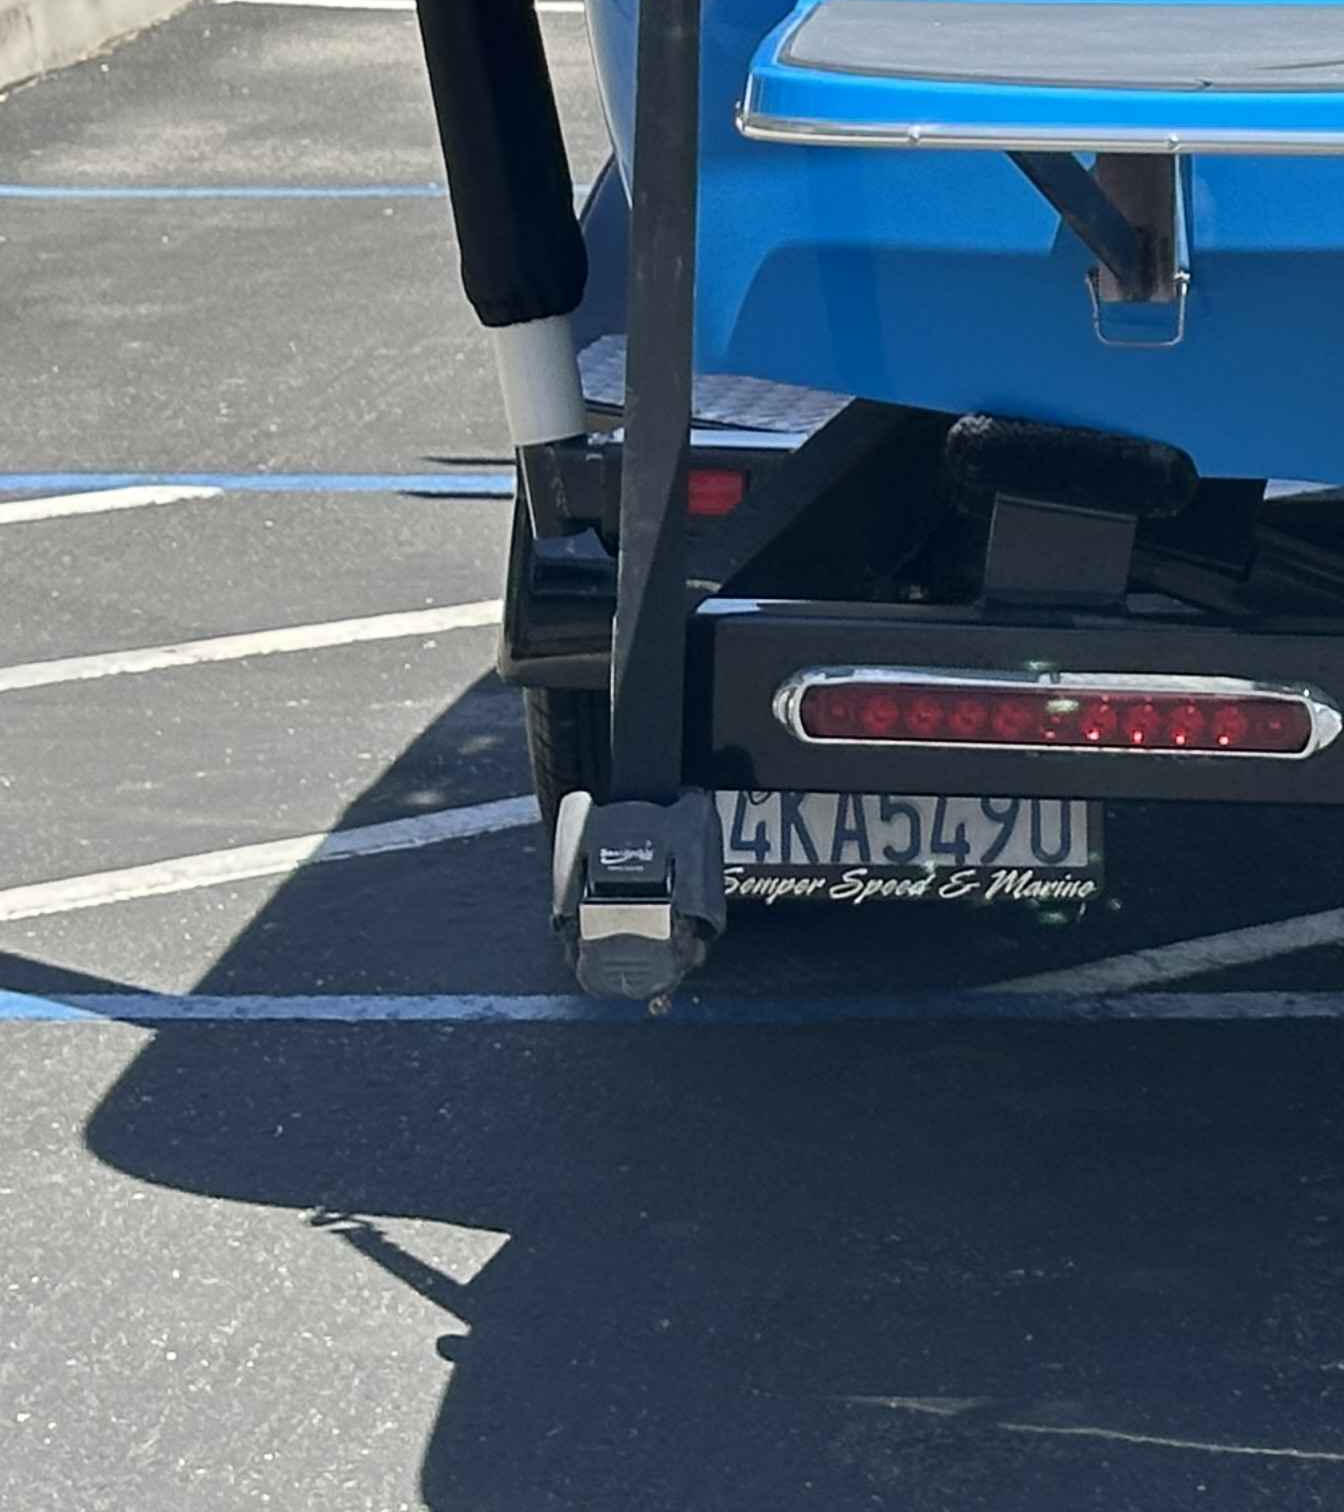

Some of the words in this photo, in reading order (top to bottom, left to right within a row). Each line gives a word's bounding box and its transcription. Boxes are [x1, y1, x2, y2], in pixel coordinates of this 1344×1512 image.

[724, 867, 825, 904] Semper
[829, 868, 936, 904] Speed
[938, 869, 980, 899] &
[984, 869, 1097, 900] Marine
